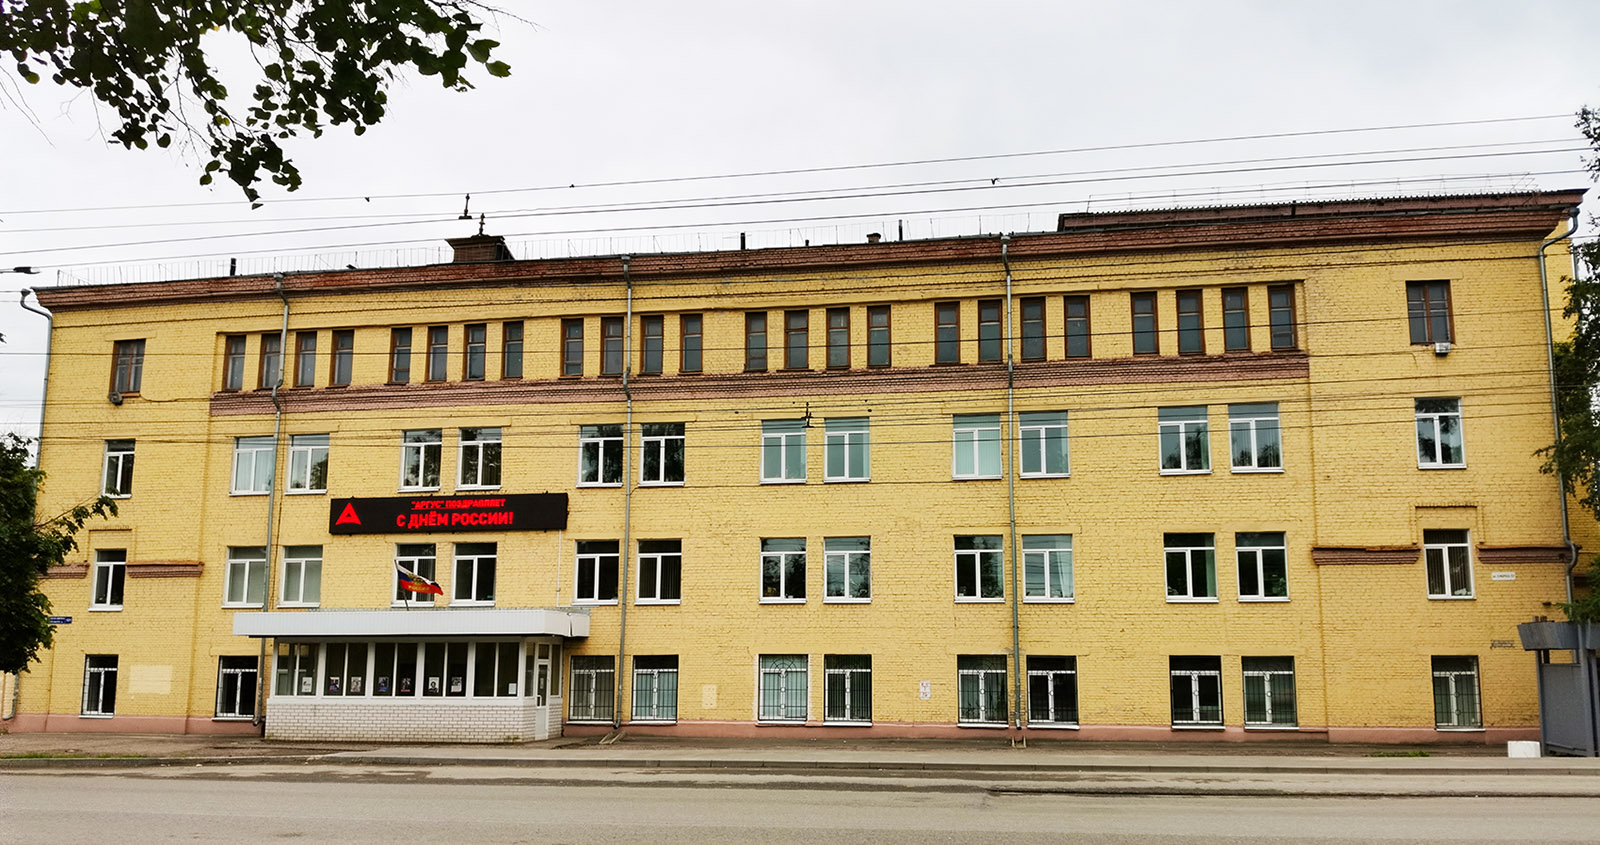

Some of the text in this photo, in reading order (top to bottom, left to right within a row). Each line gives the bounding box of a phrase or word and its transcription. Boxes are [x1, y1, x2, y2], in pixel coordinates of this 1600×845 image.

[445, 499, 506, 509] ПОЗДРАВЛЯЕТ
[396, 511, 514, 529] С ДНЁМ РОССИИ!
